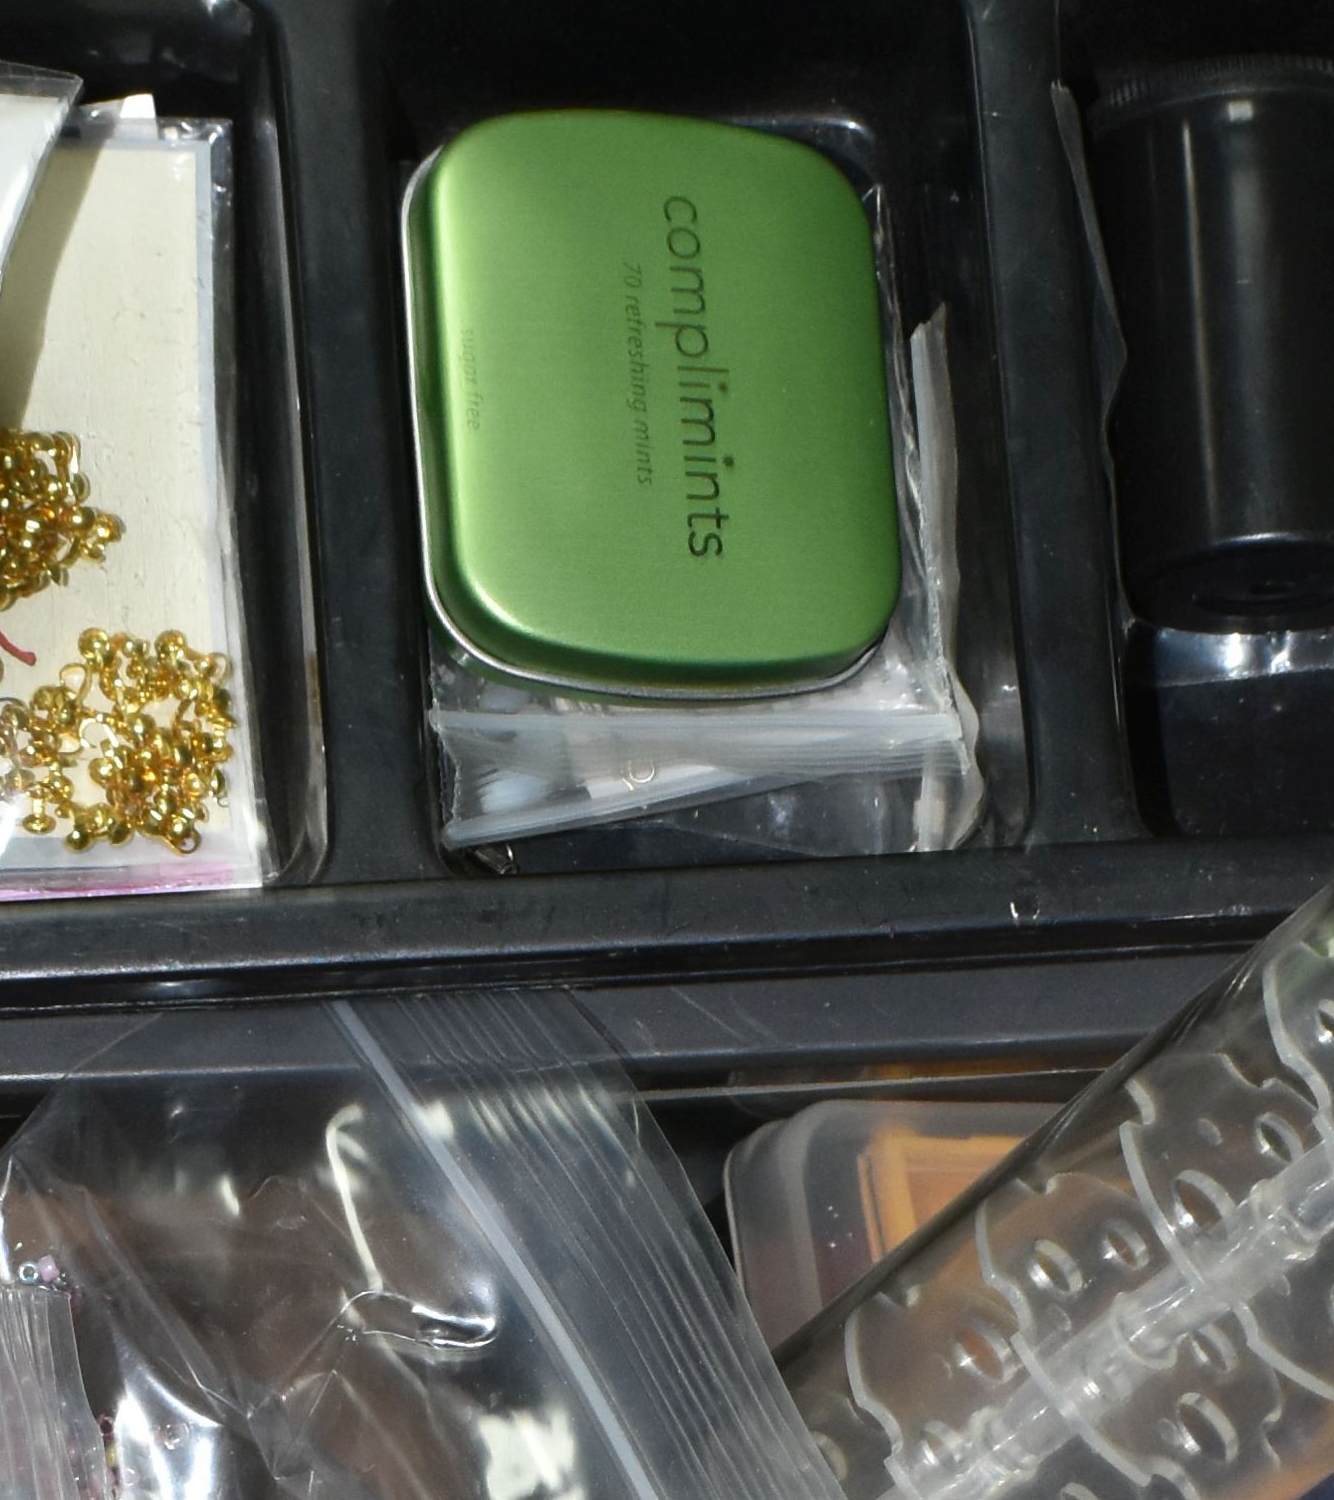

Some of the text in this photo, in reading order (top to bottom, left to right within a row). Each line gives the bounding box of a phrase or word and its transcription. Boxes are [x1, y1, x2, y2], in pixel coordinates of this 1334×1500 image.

[622, 262, 656, 486] 70 refreshing mints
[654, 195, 731, 558] complimints
